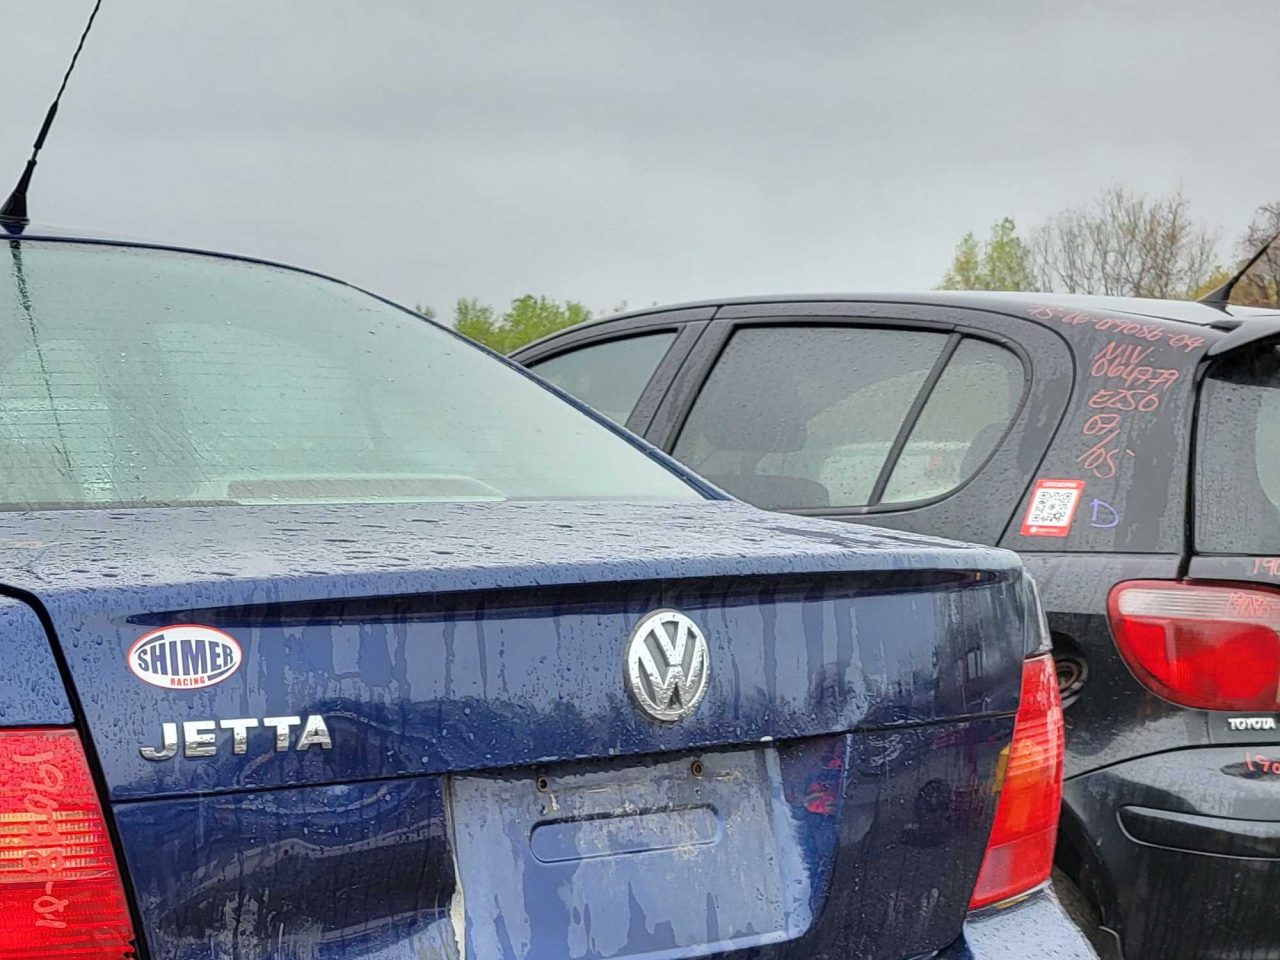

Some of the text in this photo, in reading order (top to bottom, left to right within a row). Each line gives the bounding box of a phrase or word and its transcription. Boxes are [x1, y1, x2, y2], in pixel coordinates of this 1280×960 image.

[1090, 498, 1119, 528] D
[137, 639, 234, 677] SHIMER
[170, 675, 206, 687] RACING
[139, 714, 334, 761] JETTA
[1227, 717, 1277, 730] TOYOTA
